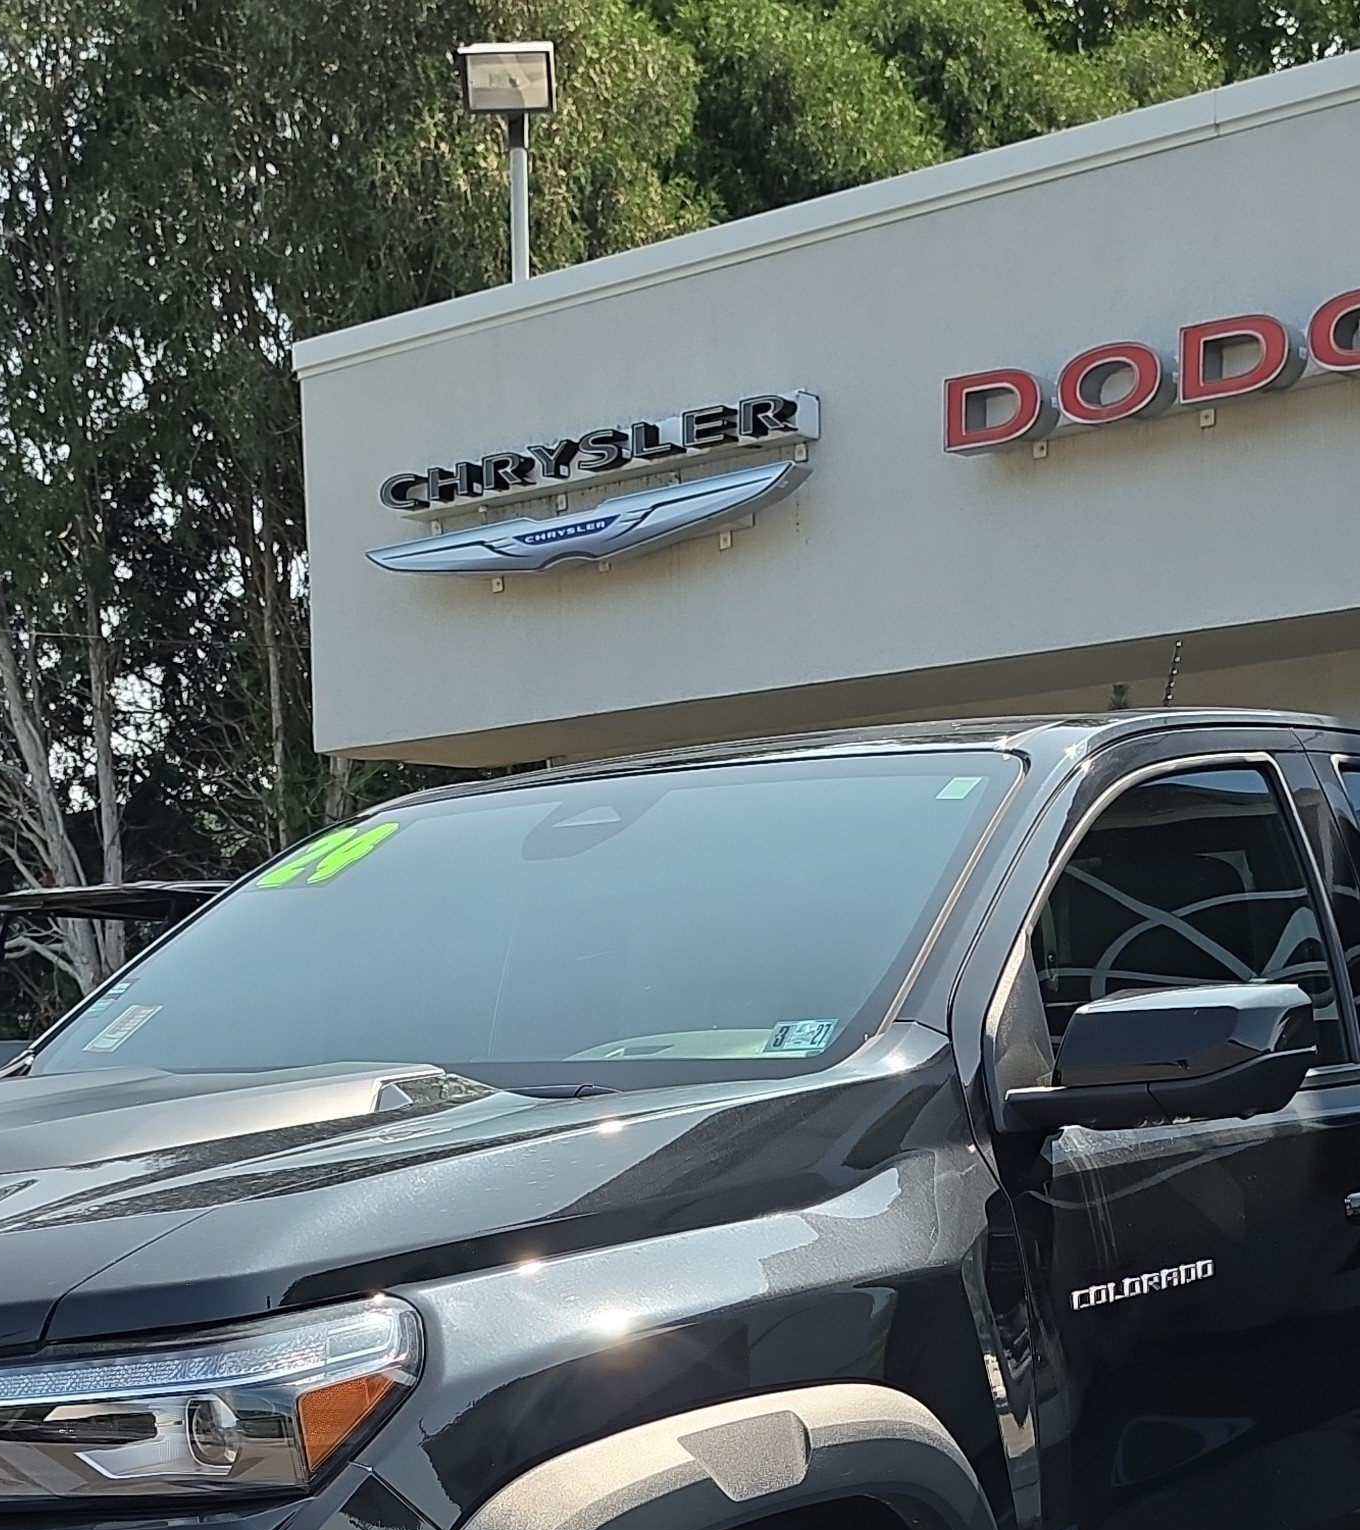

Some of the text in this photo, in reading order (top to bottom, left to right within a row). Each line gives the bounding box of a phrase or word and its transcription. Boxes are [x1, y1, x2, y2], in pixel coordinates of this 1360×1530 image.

[380, 395, 798, 509] CHRYSLER
[525, 520, 606, 543] CHRYSLER
[256, 822, 399, 889] 24
[772, 1024, 833, 1047] 3 27
[1071, 1259, 1214, 1310] COLORADO
